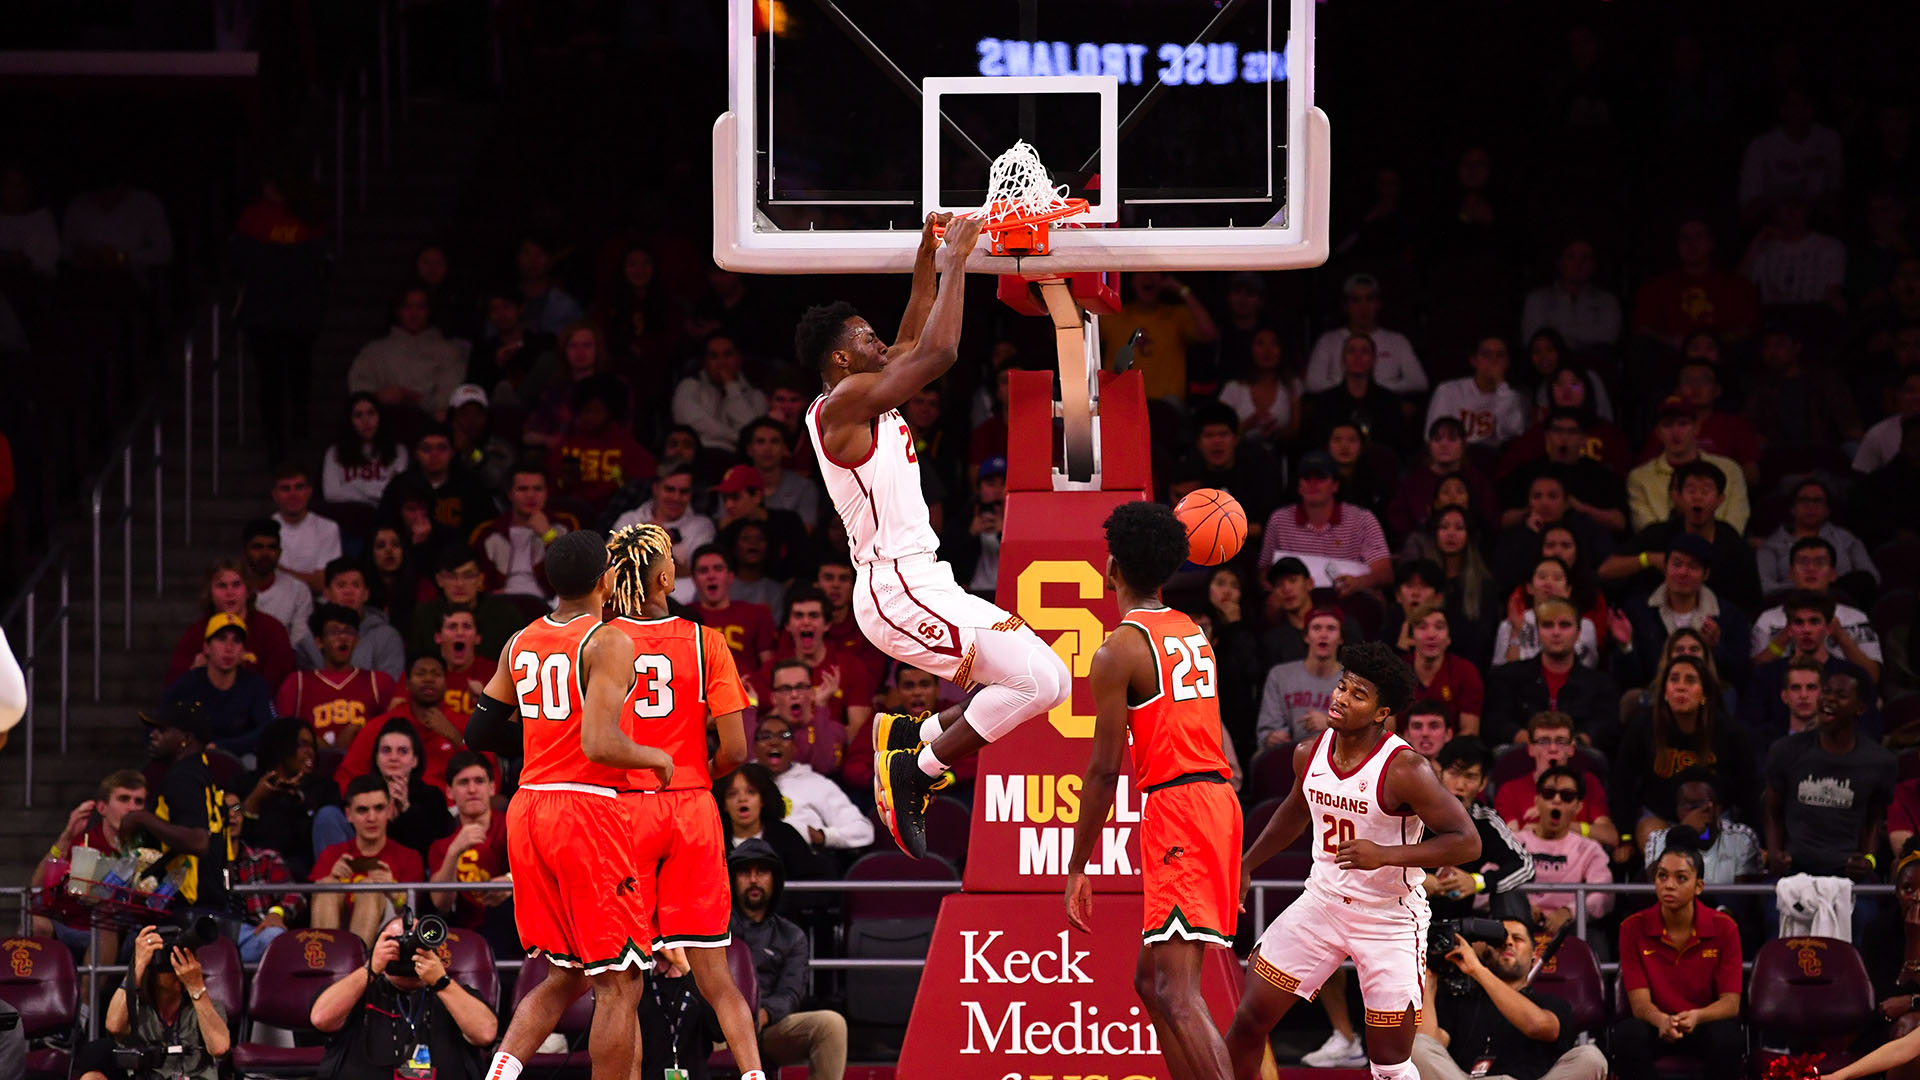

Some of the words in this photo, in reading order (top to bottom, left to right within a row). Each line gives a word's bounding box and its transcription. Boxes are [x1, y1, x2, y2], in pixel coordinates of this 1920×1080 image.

[1459, 410, 1490, 436] US
[917, 622, 944, 641] SC
[514, 650, 572, 720] 20
[634, 654, 674, 718] 3
[1162, 634, 1215, 702] 25
[312, 699, 367, 728] USC
[1285, 691, 1330, 709] TROJA
[985, 774, 1150, 823] MUSL
[1308, 788, 1368, 814] TROJANS
[1323, 814, 1355, 854] 20
[11, 949, 33, 977] SC
[960, 930, 1094, 983] Keck
[960, 1001, 1162, 1055] Medici
